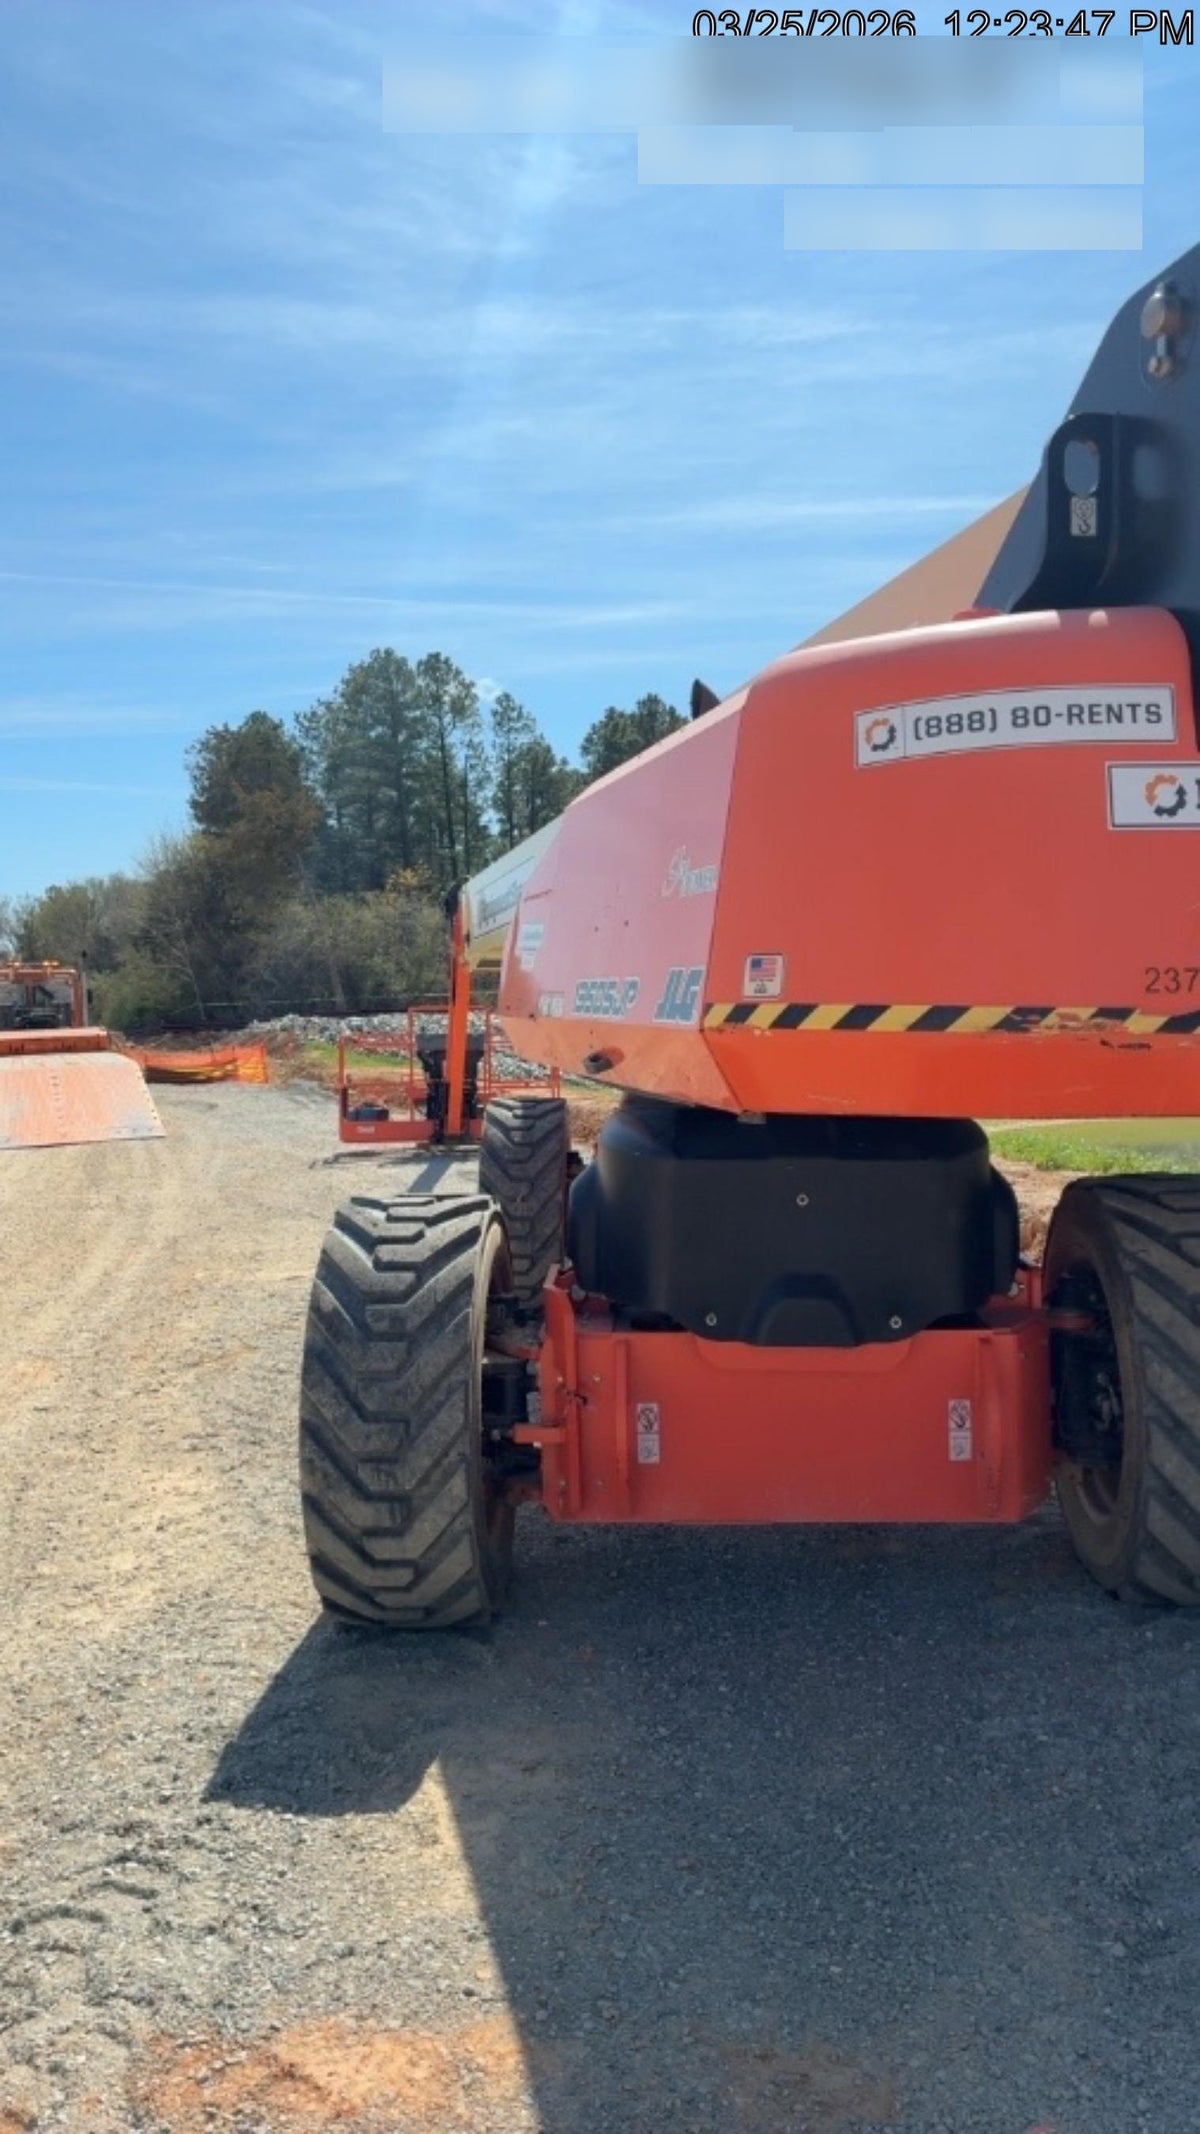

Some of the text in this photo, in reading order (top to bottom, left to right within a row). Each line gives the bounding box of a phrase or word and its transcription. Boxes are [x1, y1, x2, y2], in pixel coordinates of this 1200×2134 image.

[914, 703, 1164, 741] (888) 80-RENTS
[653, 967, 704, 1023] JLG
[1145, 967, 1200, 993] 237
